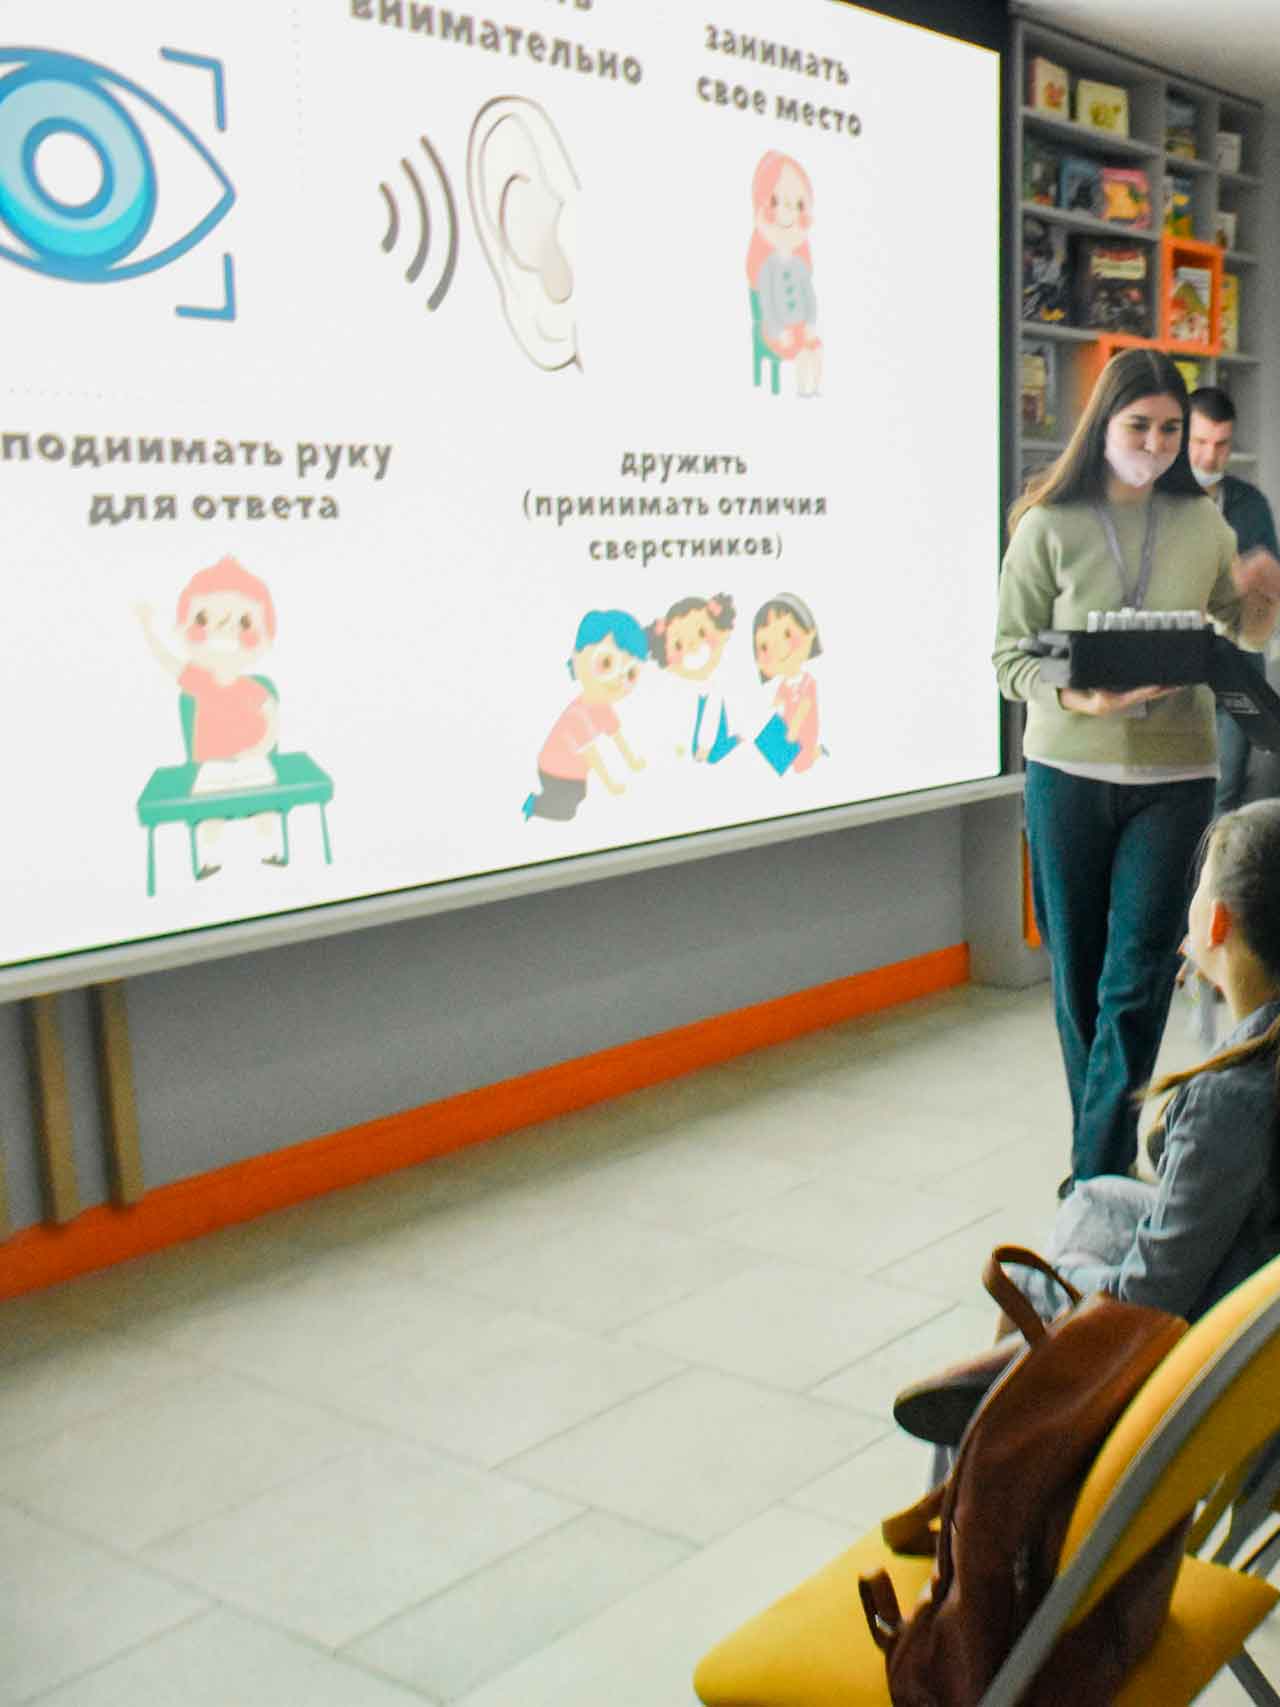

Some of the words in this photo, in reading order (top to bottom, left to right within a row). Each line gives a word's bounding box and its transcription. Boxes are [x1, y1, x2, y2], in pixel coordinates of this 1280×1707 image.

[350, 0, 643, 85] внимательно
[706, 25, 850, 85] занимать
[697, 76, 767, 116] свое
[775, 96, 862, 137] место
[2, 433, 284, 469] поднимать
[297, 443, 393, 481] руку
[620, 451, 748, 484] дружить
[88, 494, 177, 526] для
[191, 494, 340, 521] ответа
[522, 490, 710, 526] (принимать
[717, 496, 827, 516] отличия
[588, 536, 783, 569] сверстников)
